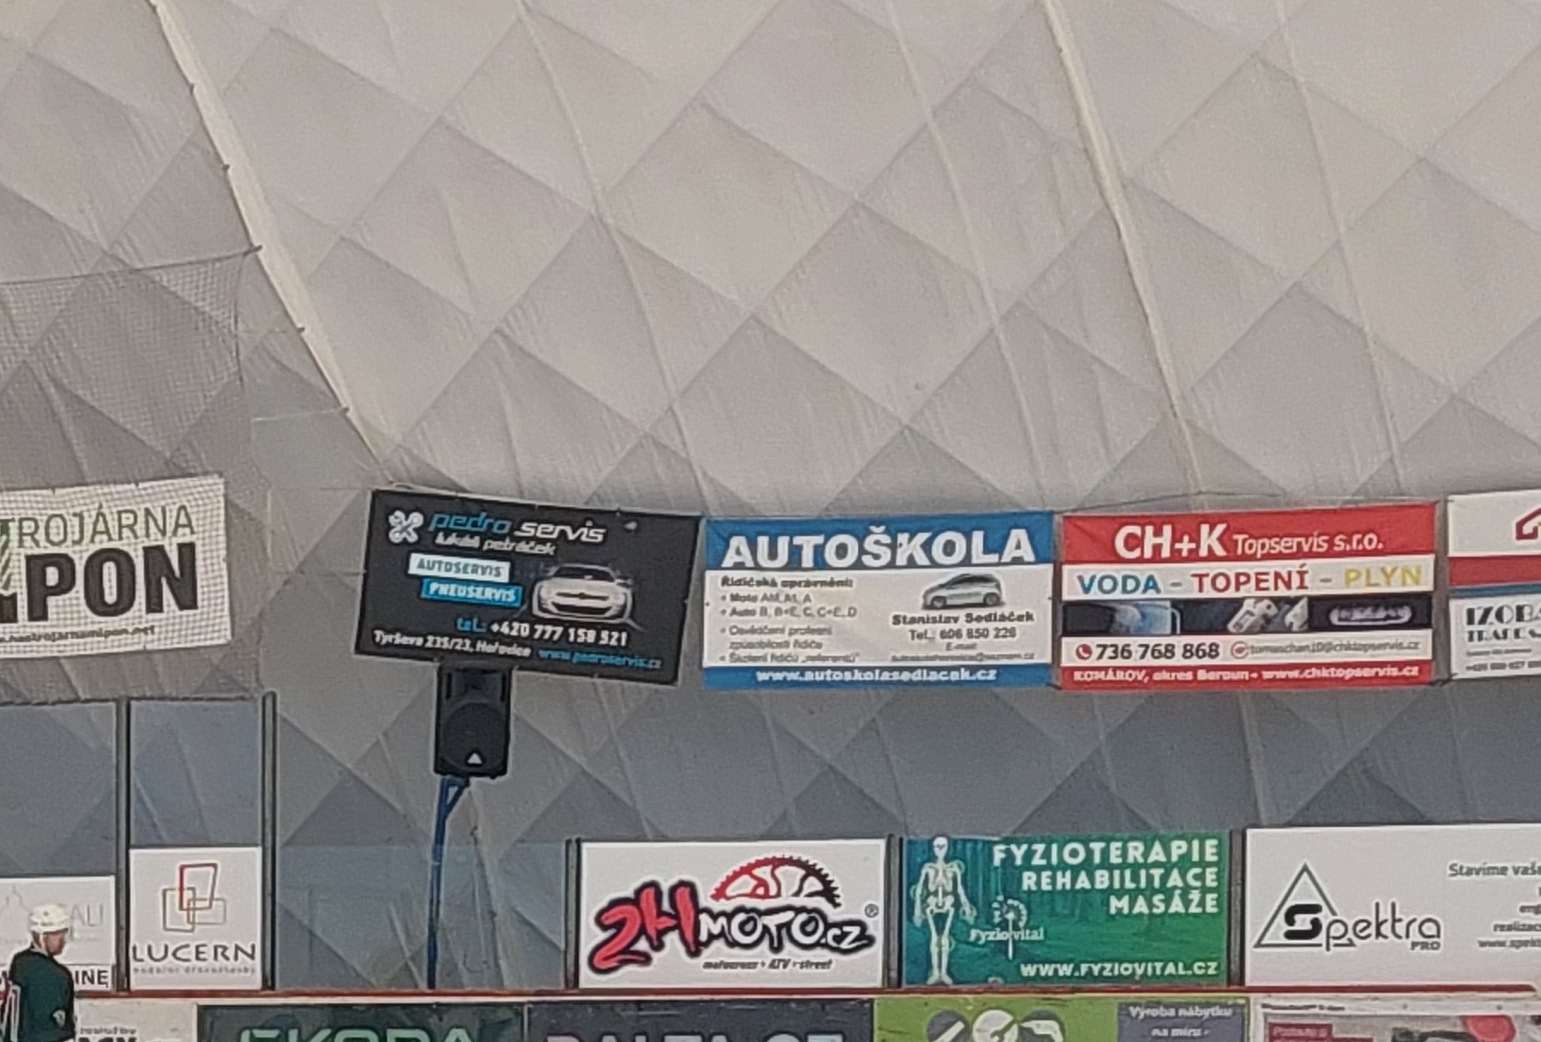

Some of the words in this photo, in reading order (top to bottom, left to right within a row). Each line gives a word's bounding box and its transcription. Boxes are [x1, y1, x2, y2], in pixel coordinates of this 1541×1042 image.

[428, 512, 512, 534] pedro
[513, 520, 607, 543] servis
[721, 525, 1035, 569] AUTOŠKOLA
[1115, 523, 1227, 560] CH+K
[1232, 532, 1328, 556] Topservis
[1333, 531, 1384, 552] s.r.o.
[416, 558, 502, 578] AUTOSERVIS
[1077, 574, 1161, 595] VODA
[1191, 563, 1309, 593] TOPENÍ
[1344, 565, 1422, 589] PLYN
[429, 582, 517, 602] PNEUSERVIS
[892, 614, 960, 626] Stanislav
[965, 611, 1035, 624] Sedláček
[1466, 604, 1541, 626] IZOB
[490, 622, 530, 638] +420
[533, 624, 564, 642] 777
[598, 629, 628, 647] 521
[1095, 642, 1132, 661] 736
[1138, 642, 1175, 660] 768
[1181, 642, 1221, 660] 868
[756, 668, 997, 684] www.autoskolasedlacek.cz
[1073, 667, 1149, 684] KOMÁROV,
[1196, 669, 1249, 681] Beroun
[1261, 664, 1419, 681] www.chktopservis.cz
[993, 839, 1219, 866] FYZIOTERAPIE
[1448, 861, 1509, 877] Stavíme
[1022, 868, 1218, 891] REHABILITACE
[1110, 889, 1218, 914] MASÁŽE
[1284, 900, 1441, 952] Spektra
[132, 943, 256, 963] LUCERN
[1411, 941, 1441, 951] PRO
[1020, 961, 1218, 979] WWW.FYZIOVITAL.CZ
[1129, 1004, 1176, 1019] Výroba
[1177, 1004, 1233, 1020] nábytku
